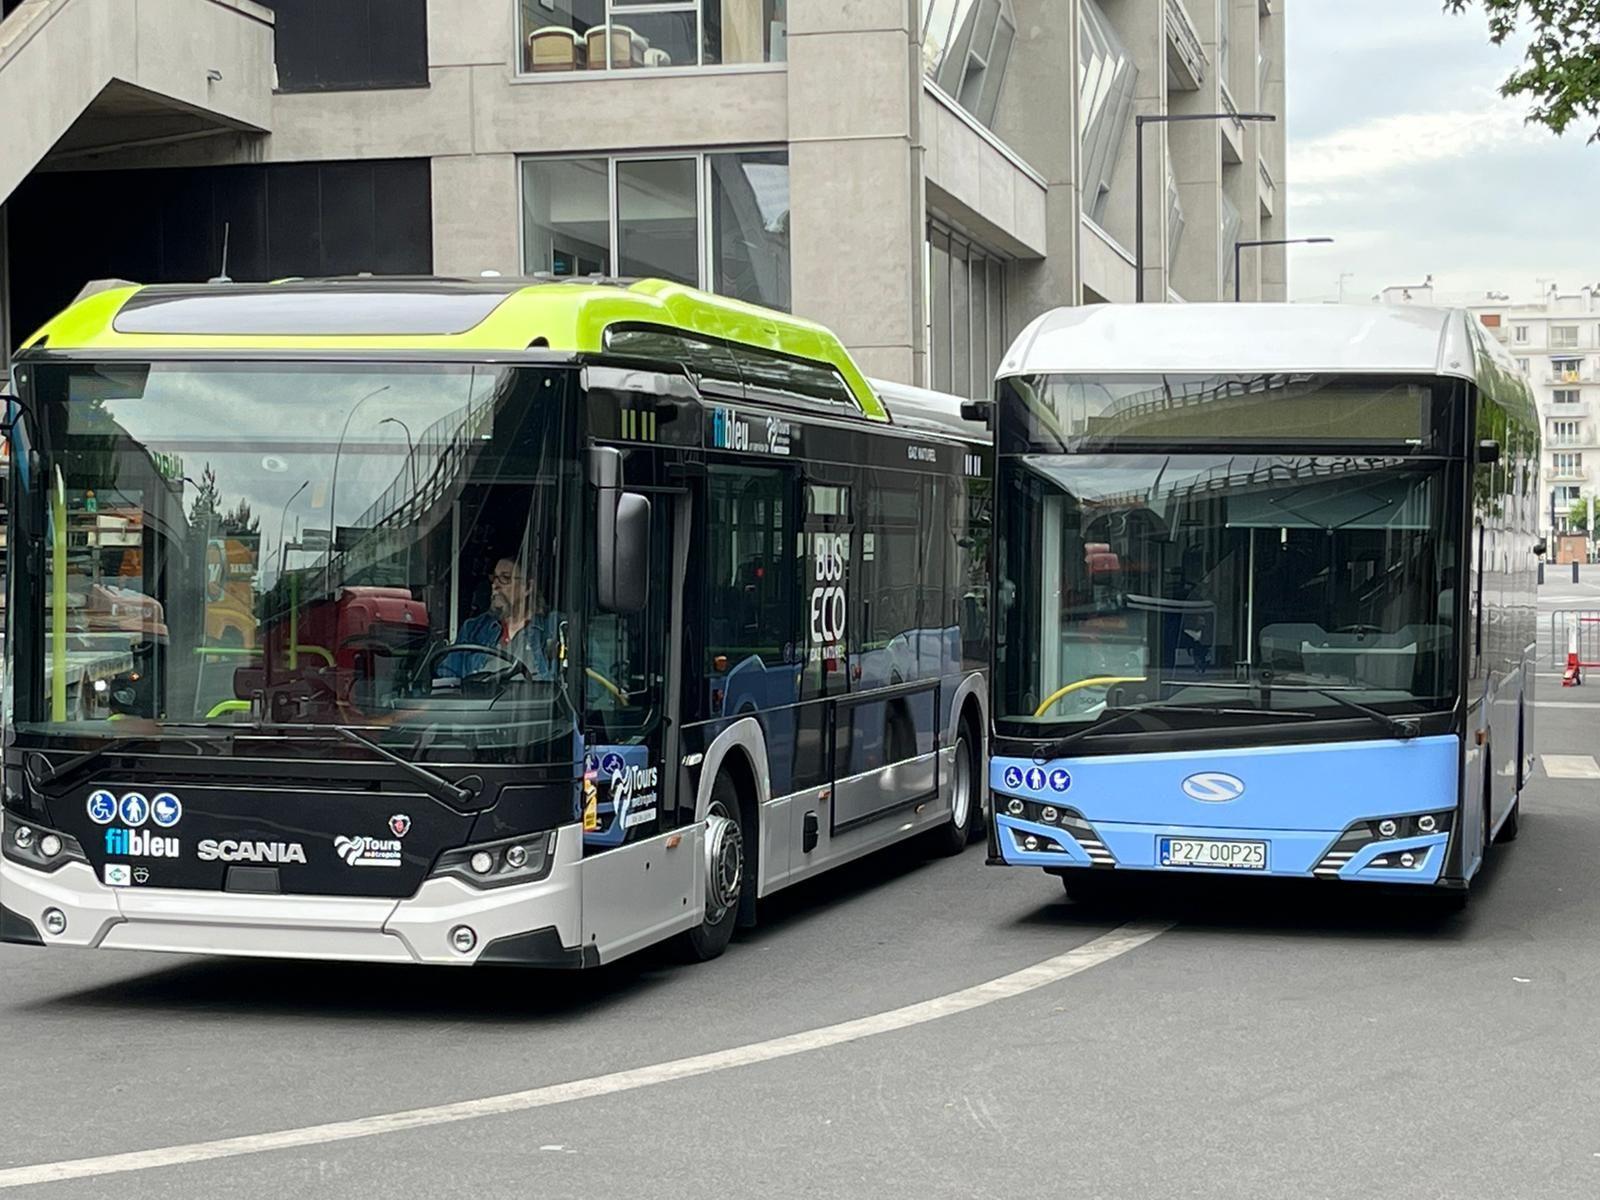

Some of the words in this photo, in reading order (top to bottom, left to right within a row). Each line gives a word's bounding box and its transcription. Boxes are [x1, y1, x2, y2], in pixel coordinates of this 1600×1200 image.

[713, 406, 749, 451] filbleu
[815, 536, 843, 581] BUS
[811, 586, 846, 643] ECO
[632, 765, 657, 791] Tours
[105, 828, 180, 858] filbleu
[198, 839, 307, 864] SCANIA
[362, 837, 402, 851] Tours
[1172, 842, 1204, 860] P27
